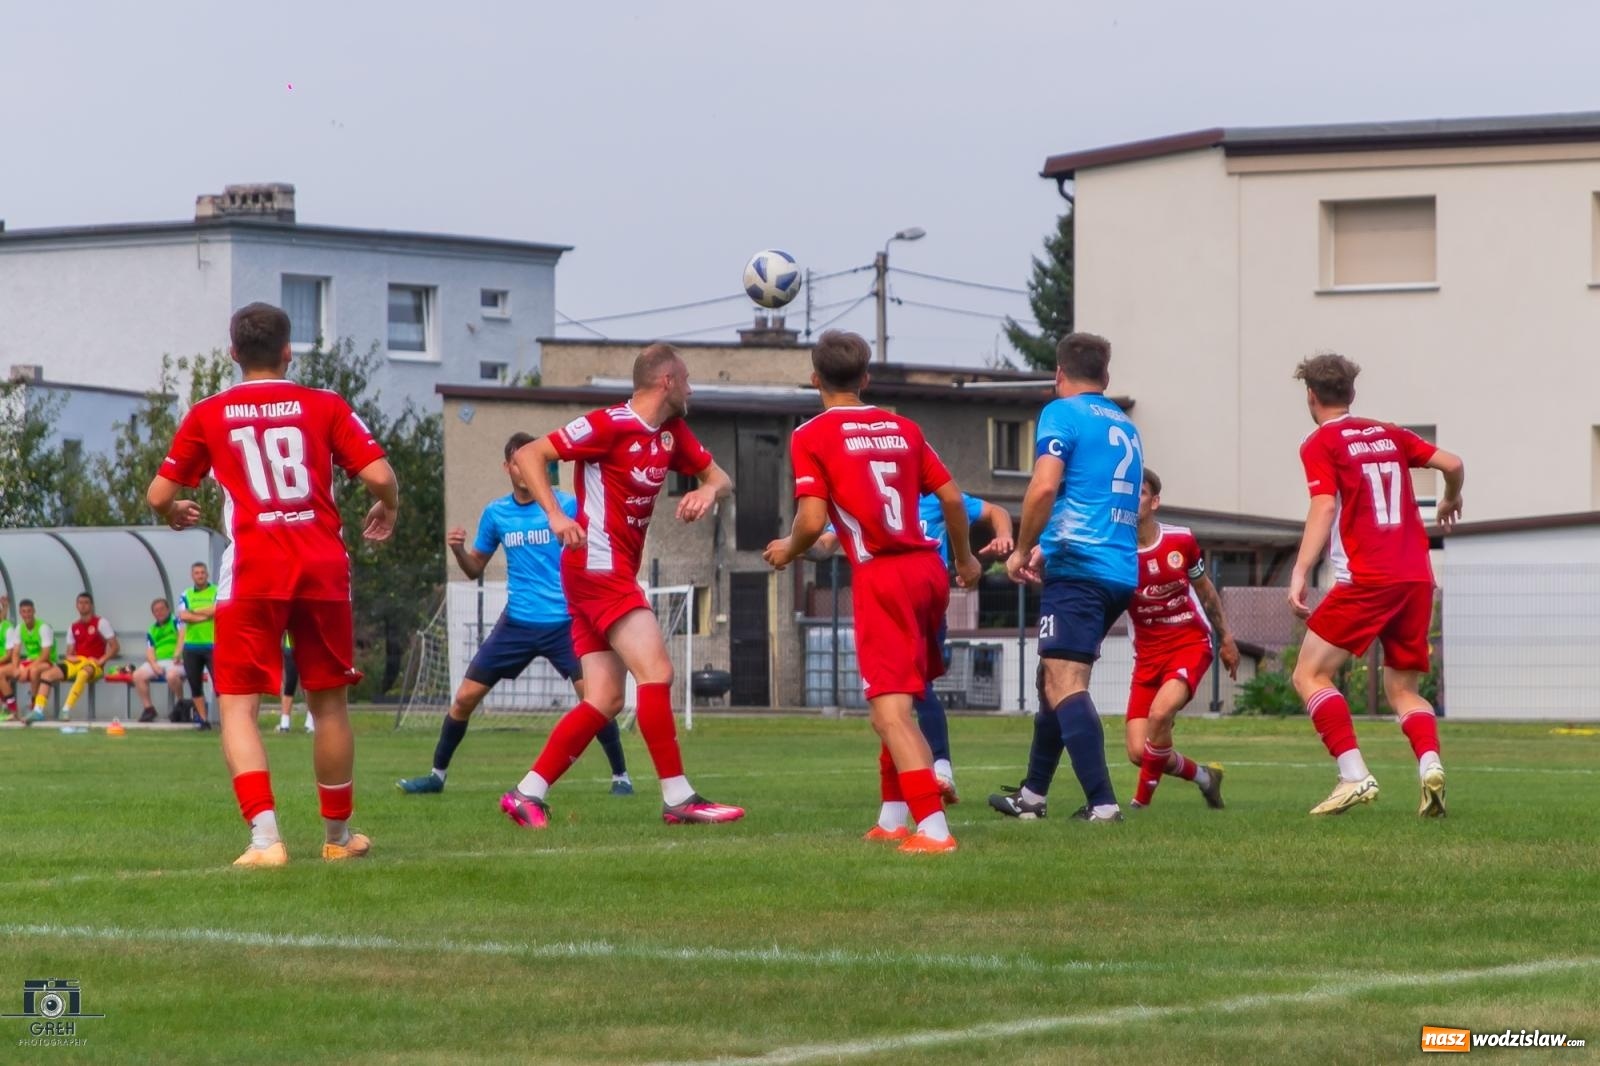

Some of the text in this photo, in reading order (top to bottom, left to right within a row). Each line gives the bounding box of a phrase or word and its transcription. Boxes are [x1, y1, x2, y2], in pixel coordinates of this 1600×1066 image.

[225, 401, 302, 418] UNIA TURZA
[846, 435, 908, 451] UNIA TURZA
[1048, 438, 1063, 456] C
[1348, 438, 1397, 456] UNIA TURZA
[230, 426, 310, 500] 18
[869, 460, 903, 530] 5
[1361, 461, 1402, 524] 17
[1039, 614, 1054, 639] 21
